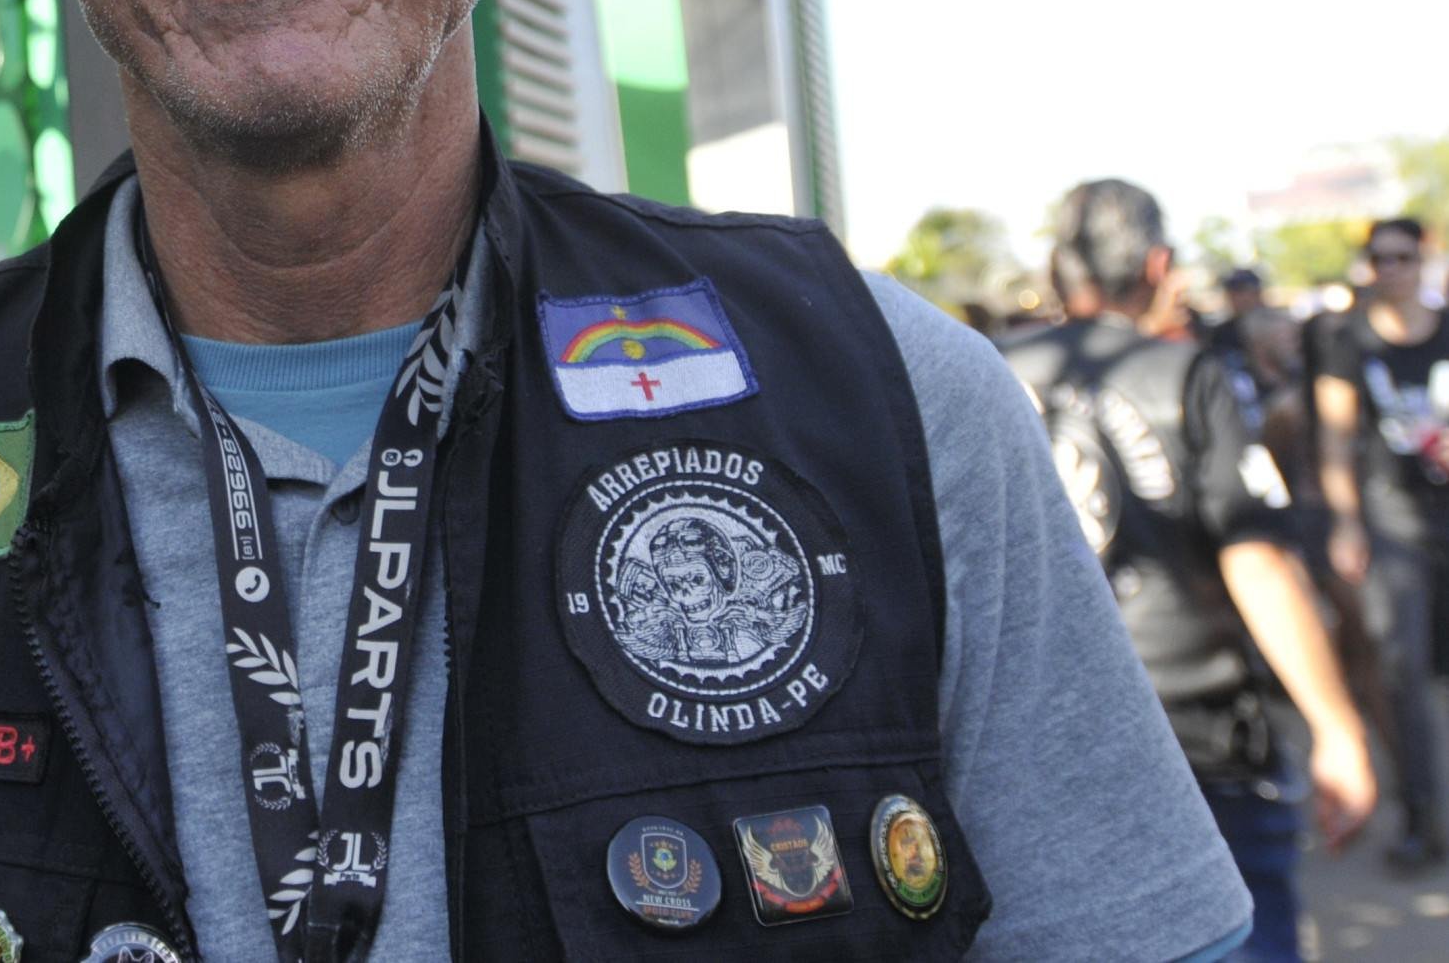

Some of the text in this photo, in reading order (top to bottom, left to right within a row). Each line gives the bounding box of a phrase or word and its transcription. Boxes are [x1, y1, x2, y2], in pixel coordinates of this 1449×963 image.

[586, 446, 764, 512] ARREPIADOS
[816, 553, 847, 575] MC
[566, 592, 590, 614] 19
[338, 470, 419, 790] JLPARTS
[646, 662, 829, 733] OLINDA-PE
[332, 832, 371, 872] JL
[642, 893, 692, 908] NEW CROSS
